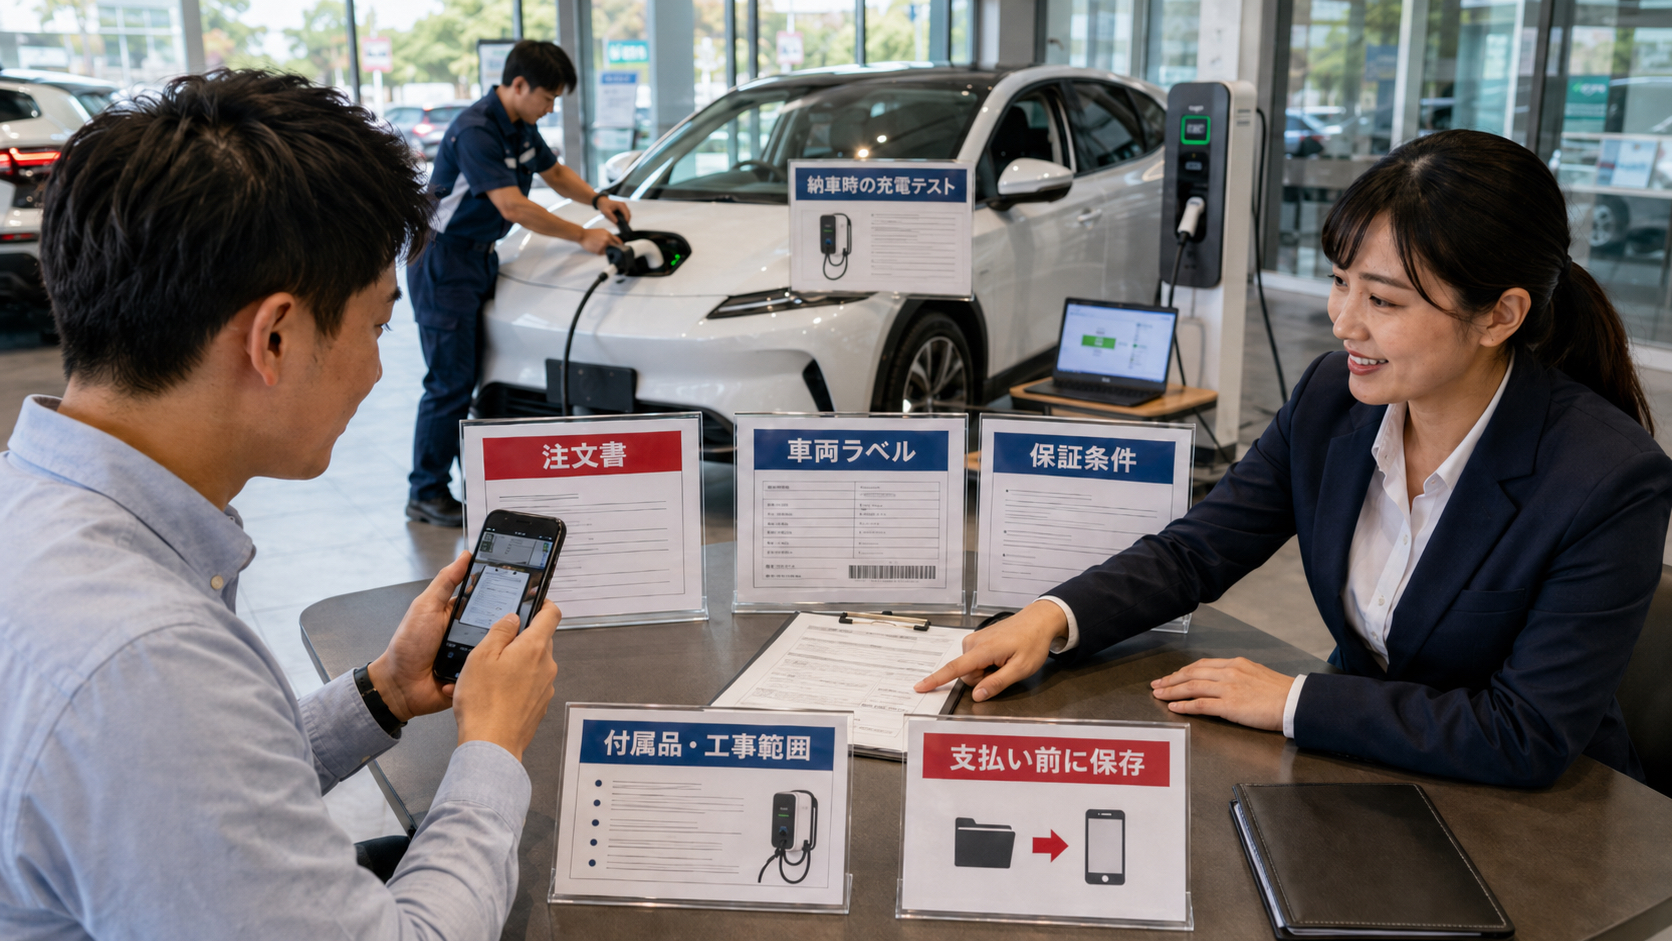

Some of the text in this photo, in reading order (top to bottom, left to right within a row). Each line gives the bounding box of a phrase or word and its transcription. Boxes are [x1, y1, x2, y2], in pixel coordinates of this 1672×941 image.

[807, 175, 956, 195] 納車時の充電テスト
[542, 441, 627, 470] 注文書
[787, 438, 917, 463] 車両ラベル
[1030, 443, 1137, 473] 保証条件
[604, 729, 811, 761] 付属品・工事範囲
[950, 744, 1145, 776] 支払い前に保存
